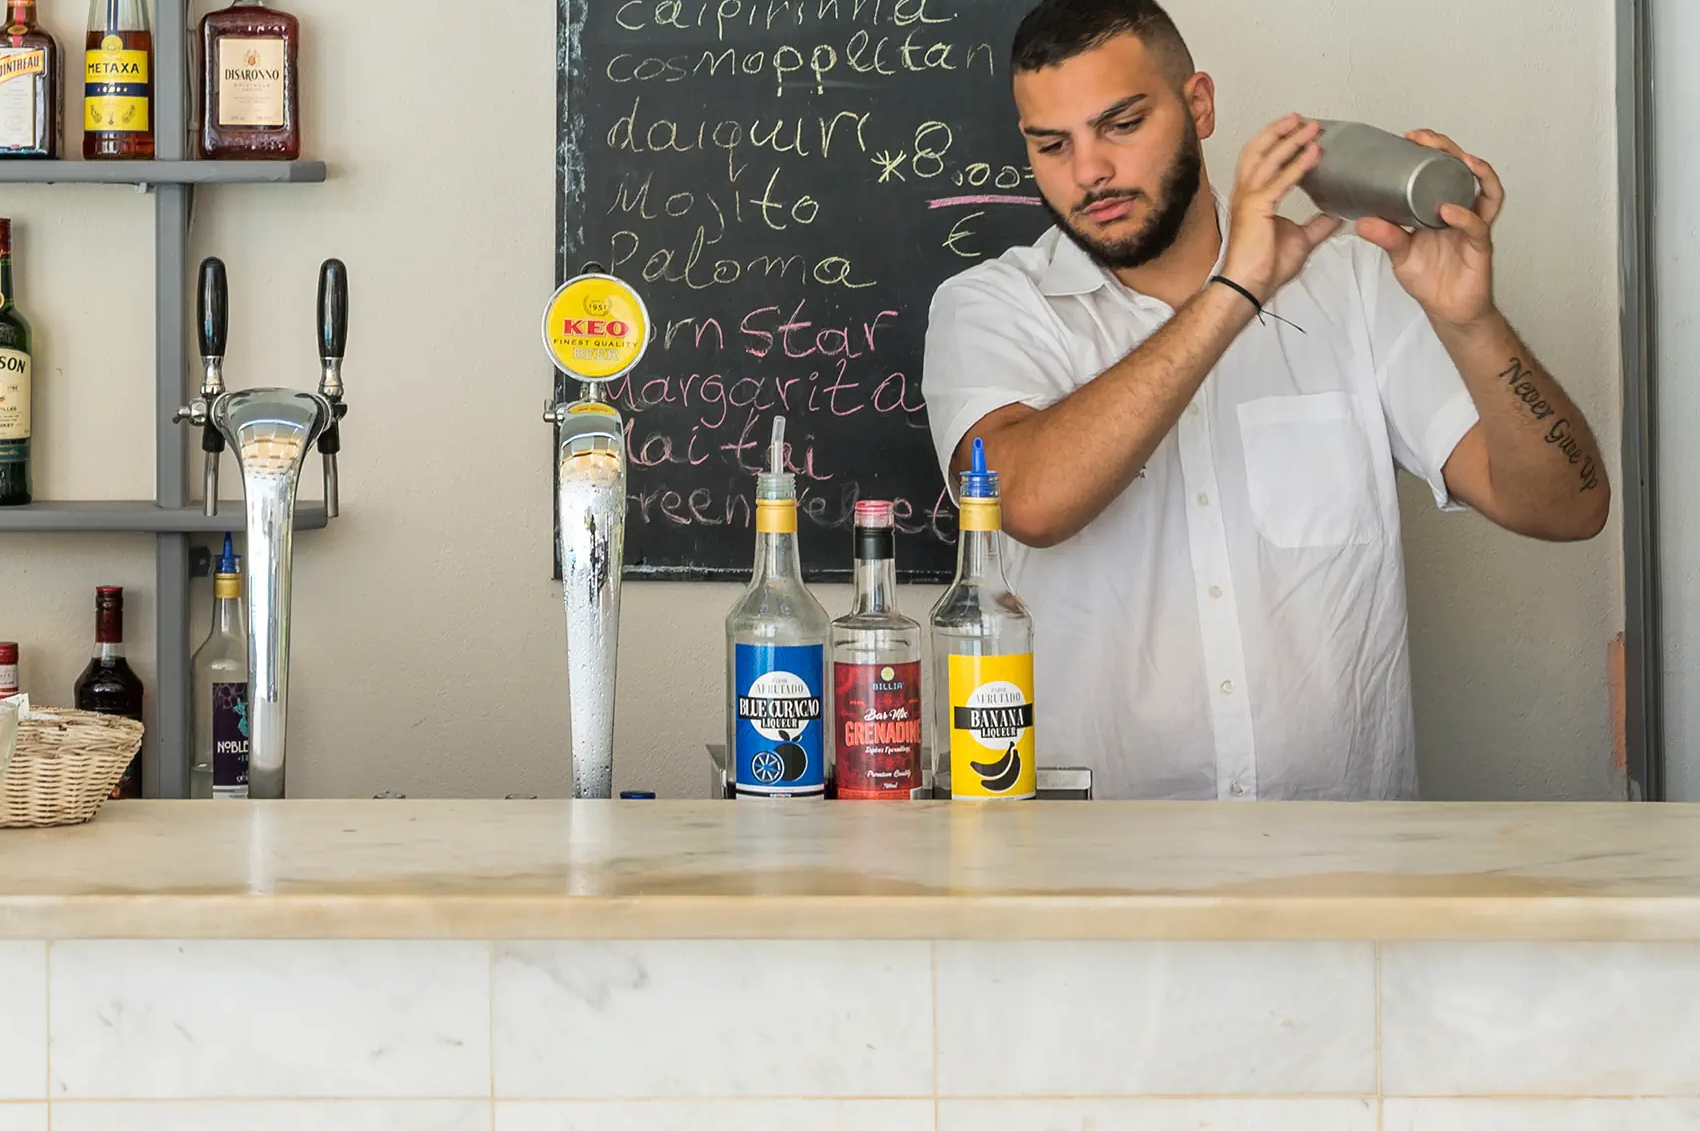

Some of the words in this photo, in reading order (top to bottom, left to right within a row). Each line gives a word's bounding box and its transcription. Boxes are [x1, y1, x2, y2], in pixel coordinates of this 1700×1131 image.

[87, 62, 140, 74] METAXA
[224, 69, 280, 82] DISARONNO
[606, 167, 819, 244] Mojito
[563, 319, 629, 337] KEO
[553, 338, 590, 346] FINEST
[593, 340, 638, 348] QUALITY
[573, 348, 620, 361] BEER
[1499, 357, 1555, 420] Never
[626, 487, 750, 528] reen
[739, 698, 767, 717] BLUE
[768, 699, 820, 719] CURACAO
[864, 708, 888, 721] Bar
[762, 718, 798, 728] LIQUEUR
[970, 708, 1024, 728] BANANA
[982, 727, 1017, 737] LIQUEUR
